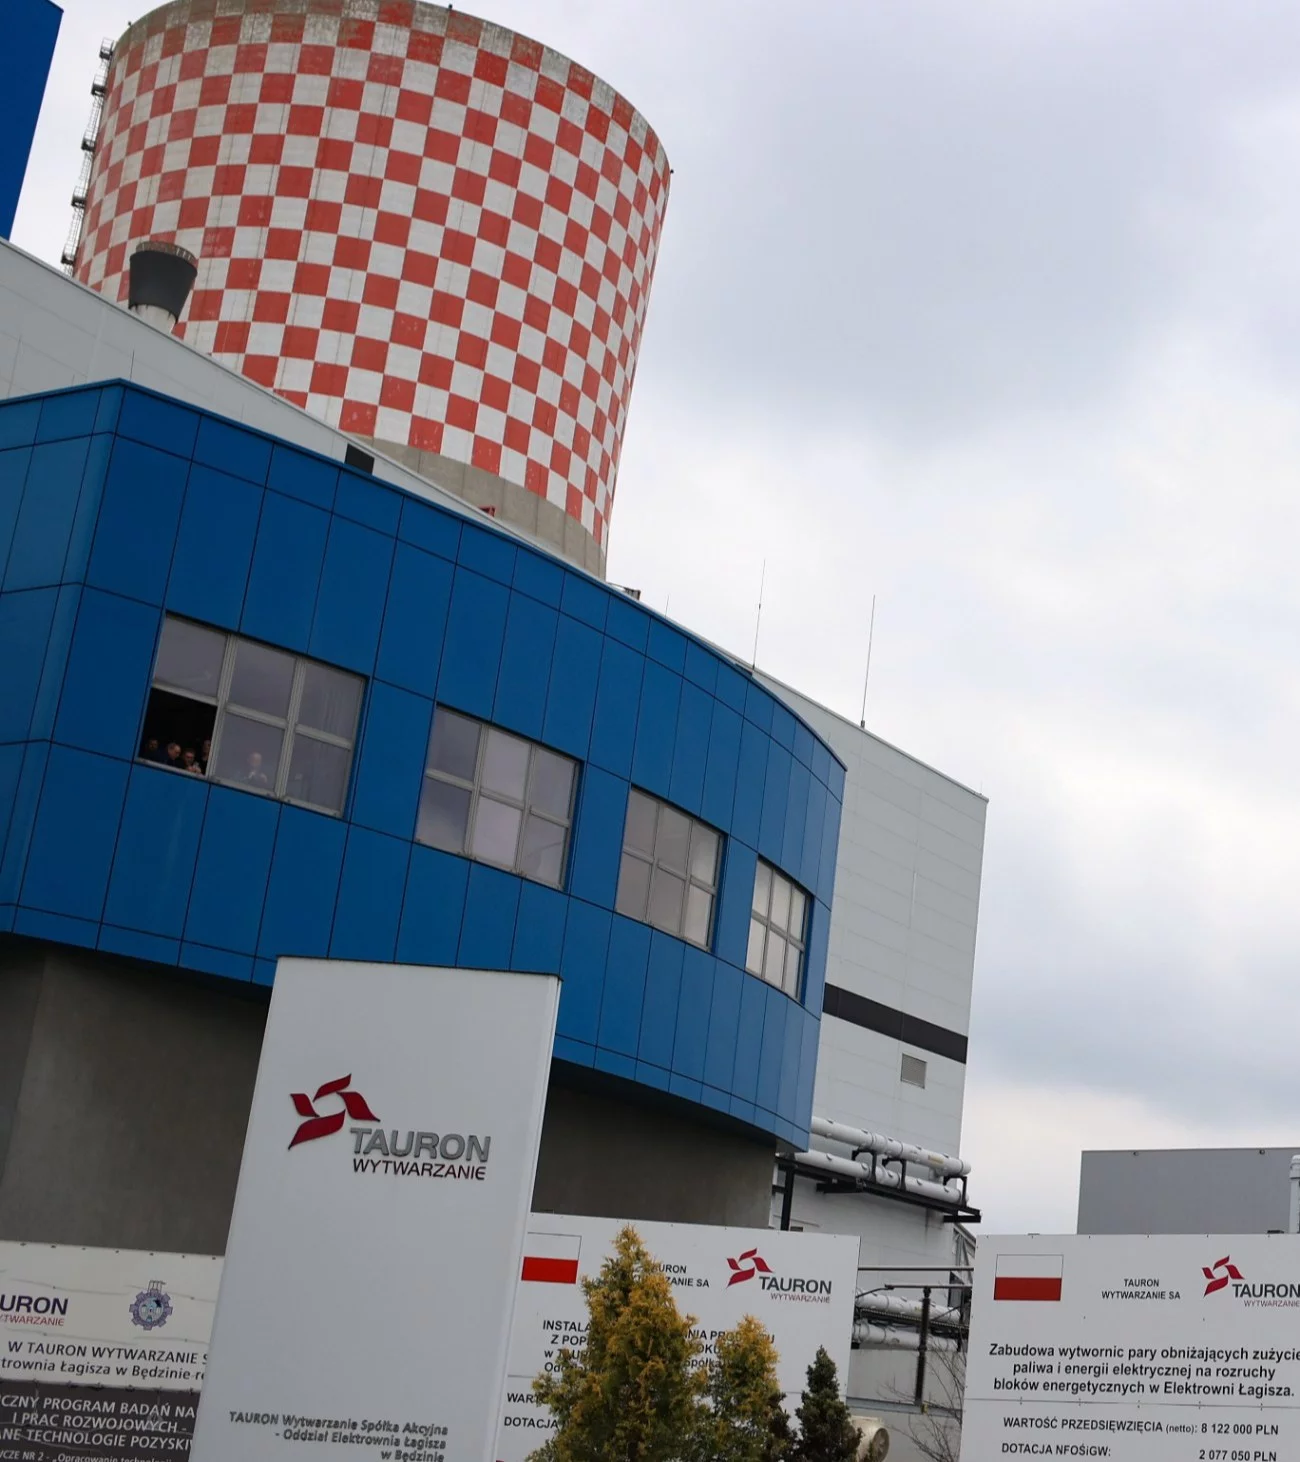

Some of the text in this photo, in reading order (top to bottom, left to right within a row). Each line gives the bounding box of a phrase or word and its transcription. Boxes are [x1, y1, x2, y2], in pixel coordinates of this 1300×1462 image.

[350, 1127, 491, 1162] TAURON
[353, 1158, 487, 1180] WYTWARZANIE
[659, 1263, 687, 1274] URON
[696, 1278, 710, 1288] SA
[759, 1276, 832, 1294] TAURON
[1124, 1278, 1160, 1288] TAURON
[1232, 1284, 1300, 1298] TAURON
[770, 1293, 830, 1304] WYTWARZANIE
[1101, 1291, 1181, 1300] WYTWARZANIE SA
[1244, 1300, 1300, 1308] WYTWARZANIE
[542, 1320, 592, 1333] INSTALA
[551, 1334, 559, 1345] Z
[8, 1341, 22, 1353] W
[28, 1342, 87, 1357] TAURON
[92, 1346, 198, 1364] WYTWARZANIE
[544, 1350, 554, 1358] w
[989, 1343, 1055, 1357] Zabudowa
[1058, 1345, 1124, 1361] wytwornic
[1128, 1348, 1157, 1361] pary
[1161, 1346, 1249, 1363] obniżających
[60, 1360, 111, 1376] Łagisza
[115, 1366, 128, 1376] w
[132, 1365, 191, 1380] Będzinie
[1013, 1361, 1276, 1382] paliwa i energii elektrycznej na rozruchy
[993, 1378, 1295, 1399] bloków energetycznych w Elektrowni Łagisza.
[0, 1394, 195, 1418] CZNY PROGRAM BADAŃ NA
[12, 1412, 17, 1424] I
[21, 1412, 60, 1426] PRAC
[63, 1415, 177, 1433] ROZWOJOWYCH
[229, 1411, 448, 1437] TAURON Wytwarzanie Spółka Akcyjna
[504, 1416, 559, 1429] DOTACJA
[1003, 1416, 1279, 1435] WARTOŚĆ PRZEDSIĘWZIĘCIA (netto): 8 122 000 PLN
[26, 1429, 126, 1447] TECHNOLOGIE
[130, 1435, 191, 1451] POZYSKI
[283, 1428, 329, 1442] Oddział
[331, 1431, 401, 1447] Elektrownia
[404, 1436, 446, 1450] Łagisza
[22, 1451, 36, 1460] NR
[38, 1452, 44, 1461] 2
[381, 1449, 445, 1462] w Będzinie
[1001, 1442, 1277, 1462] DOTACJA NFOŚiGW: 2 077 050 PLN
